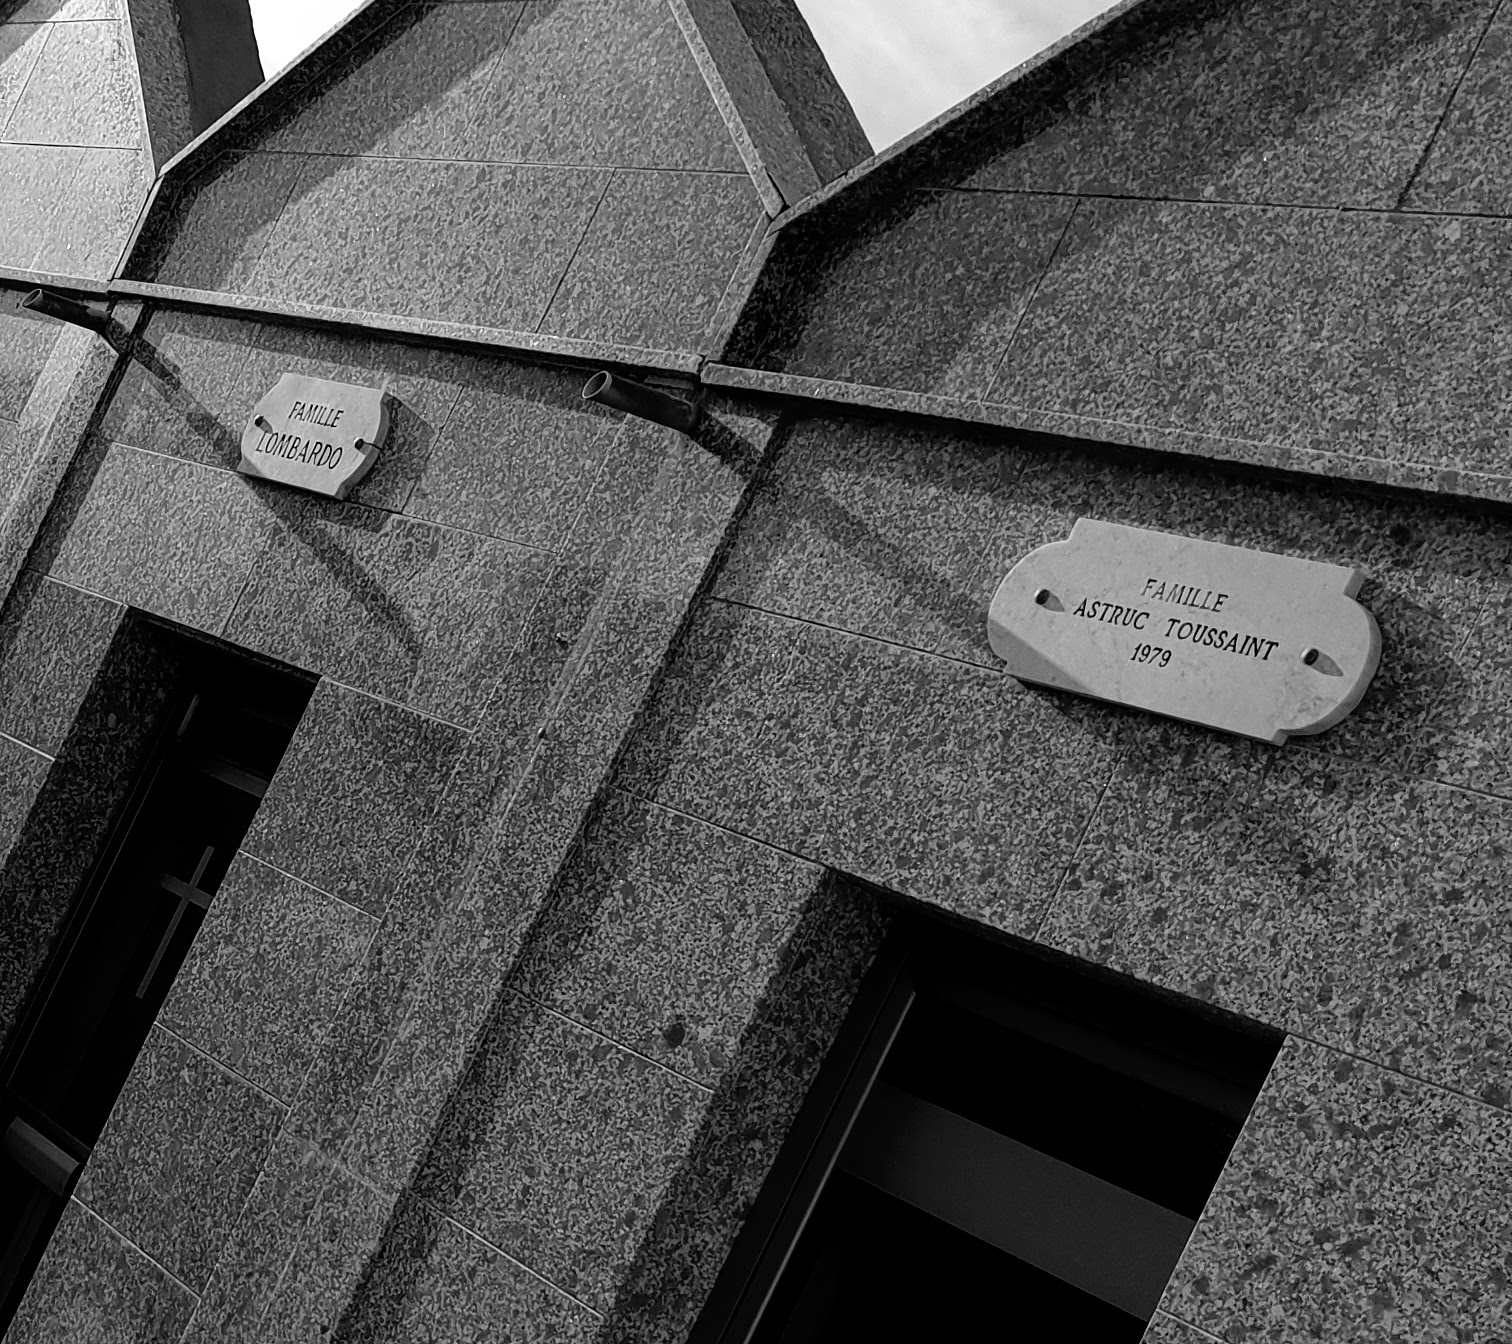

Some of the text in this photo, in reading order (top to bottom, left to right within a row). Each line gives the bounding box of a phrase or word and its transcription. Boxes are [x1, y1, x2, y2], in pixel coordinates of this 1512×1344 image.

[288, 401, 345, 428] FAMILLE
[254, 430, 343, 470] LOMBARDO
[1140, 578, 1229, 613] FAMILLE
[1072, 597, 1280, 662] ASTRUC TOUSSAINT
[1129, 642, 1173, 668] 1979
